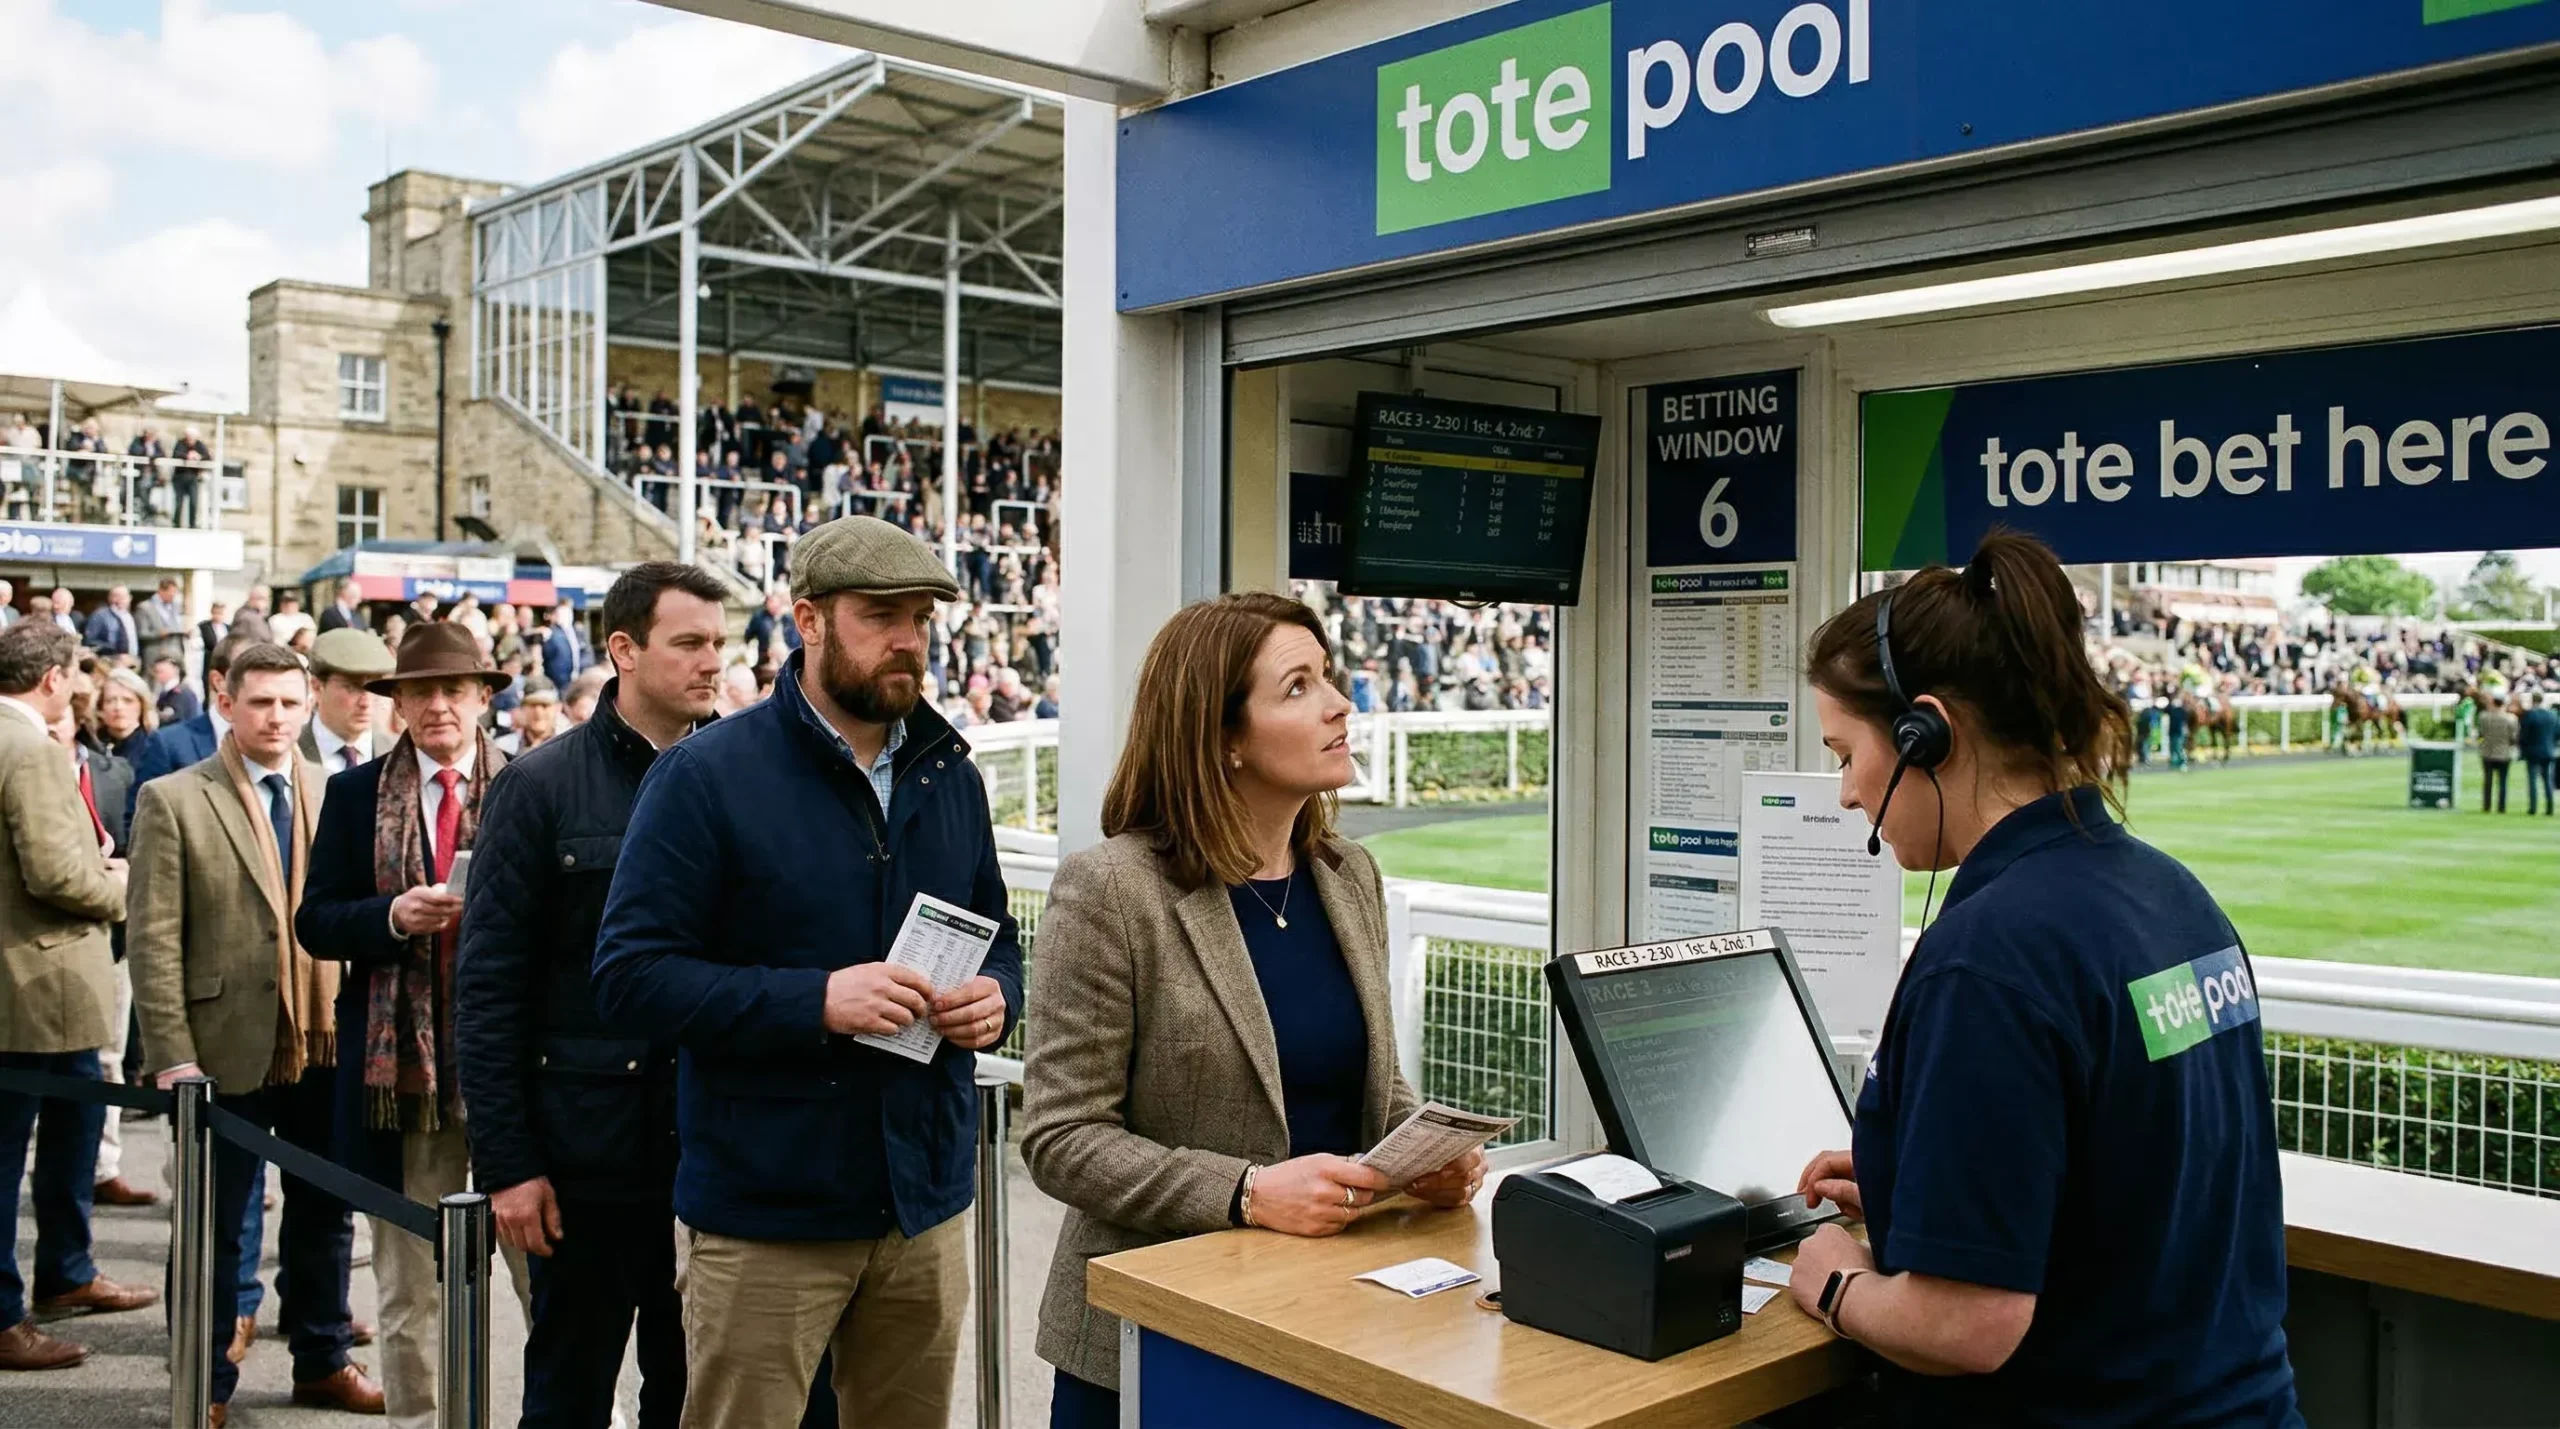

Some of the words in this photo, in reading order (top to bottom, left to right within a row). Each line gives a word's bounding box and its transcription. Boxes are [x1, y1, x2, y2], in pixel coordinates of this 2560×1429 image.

[1397, 57, 1592, 182] tote
[1627, 0, 1870, 161] pool
[1663, 385, 1778, 423] BETTING
[1379, 409, 1413, 427] RACE
[1415, 412, 1423, 427] 3
[1432, 414, 1460, 431] 2:30
[1536, 425, 1546, 439] 7
[1657, 424, 1783, 462] WINDOW
[1980, 430, 2134, 508] tote
[2160, 413, 2302, 498] bet
[2328, 405, 2551, 490] here
[1699, 477, 1739, 548] 6
[1680, 834, 1702, 848] pool
[1594, 951, 1630, 969] RACE
[1629, 950, 1639, 963] 3
[1746, 935, 1754, 947] 7
[1587, 981, 1637, 1005] RACE
[1640, 978, 1653, 996] 3
[2146, 980, 2203, 1035] tote
